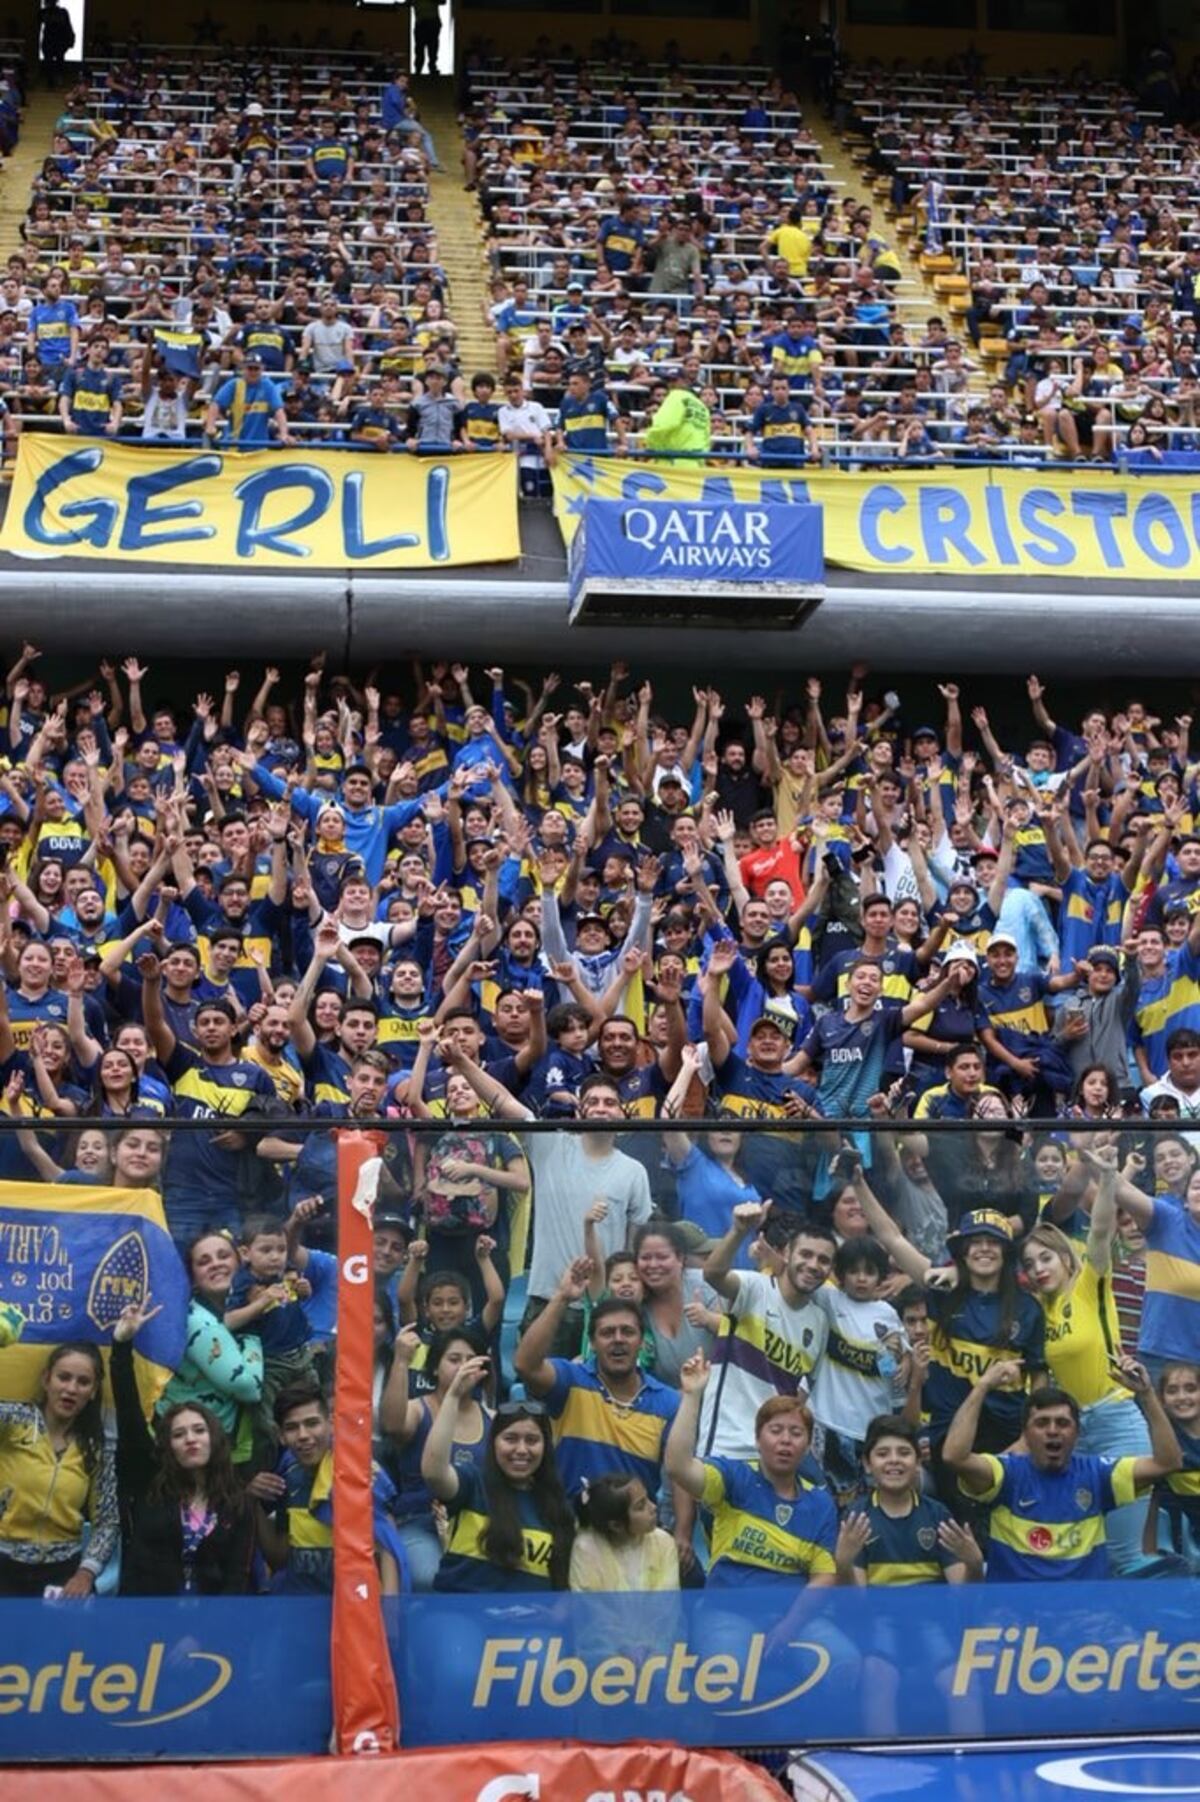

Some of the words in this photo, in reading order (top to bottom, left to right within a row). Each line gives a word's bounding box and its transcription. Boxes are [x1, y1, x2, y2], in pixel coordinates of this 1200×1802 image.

[23, 447, 450, 561] GERLI
[625, 508, 771, 550] QATAR
[859, 484, 1200, 569] CRISTO
[659, 545, 772, 568] AIRWAYS
[831, 1046, 863, 1063] BBVA
[342, 1255, 368, 1284] G
[473, 1634, 765, 1707] Fibertel
